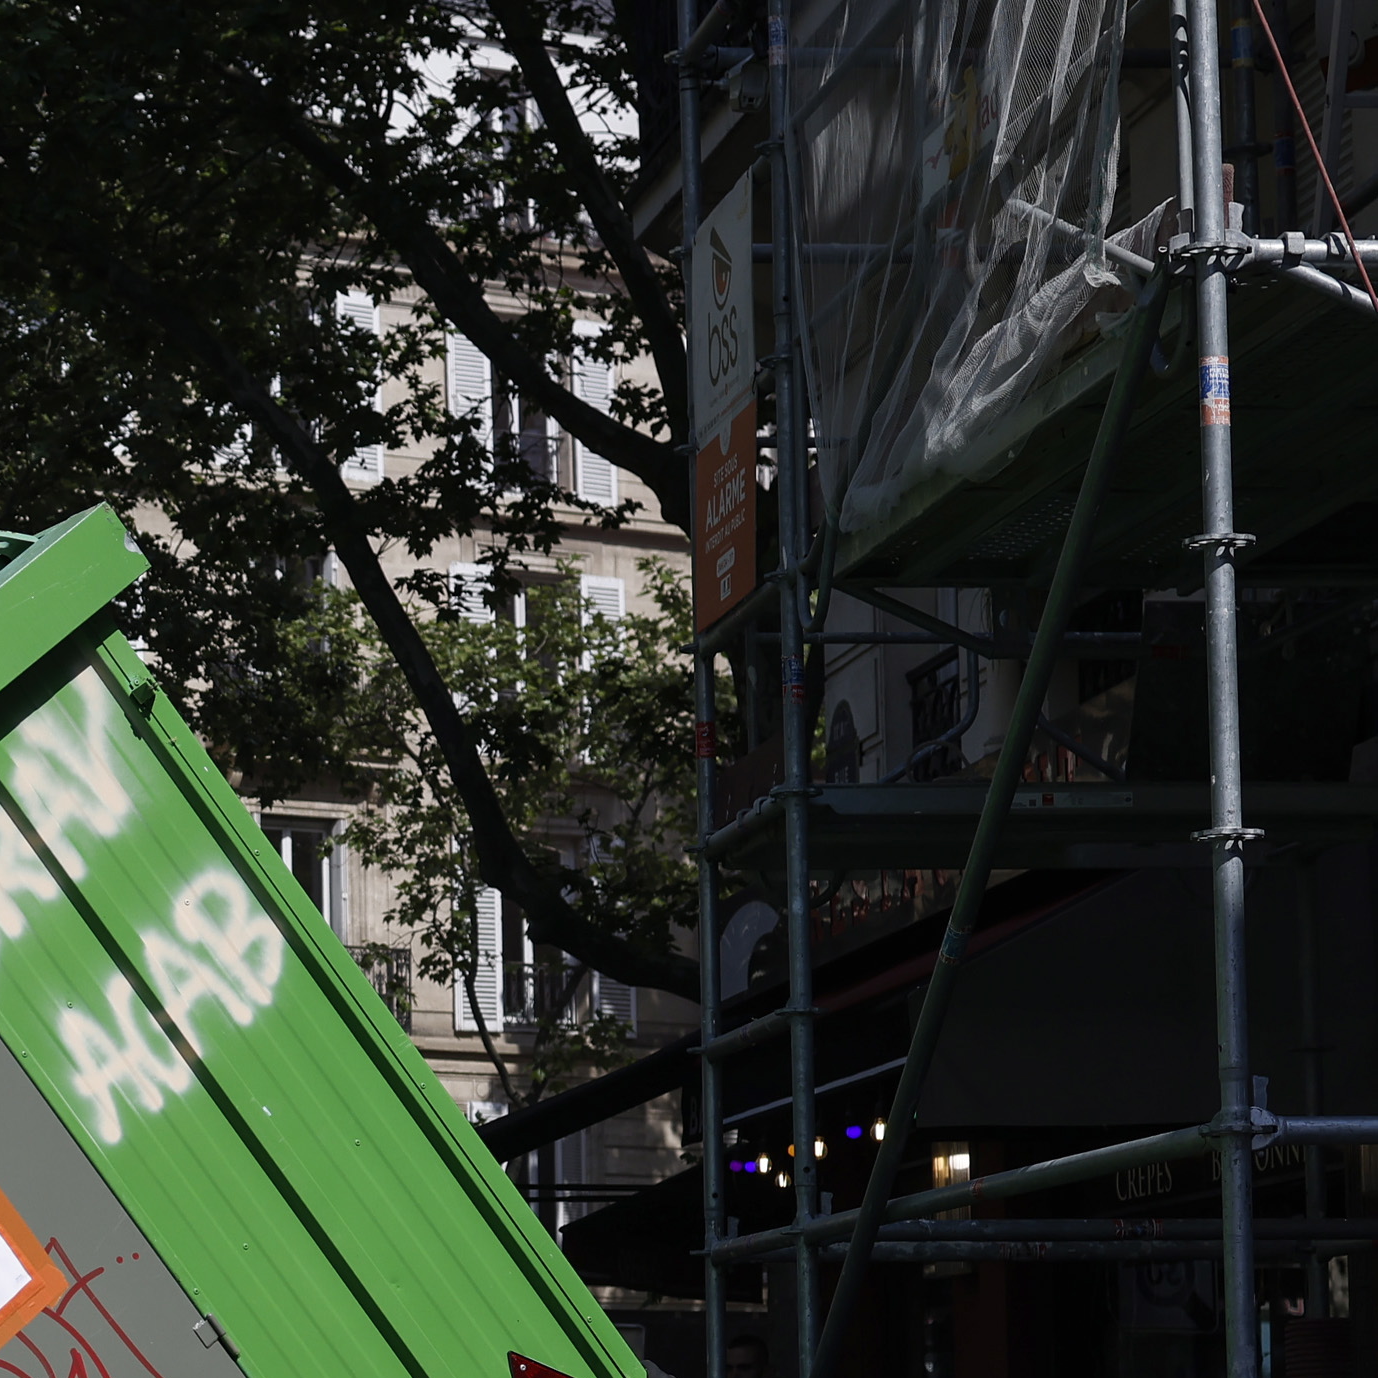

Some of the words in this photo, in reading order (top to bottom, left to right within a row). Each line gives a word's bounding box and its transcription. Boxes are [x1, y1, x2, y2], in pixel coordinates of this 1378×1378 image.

[707, 308, 740, 387] bss
[705, 466, 746, 533] ALARME
[713, 464, 725, 488] SITE
[724, 452, 738, 479] SOUS
[705, 527, 725, 555] INTERDIT
[731, 508, 746, 536] PUBLIC
[54, 868, 287, 1146] ACAB
